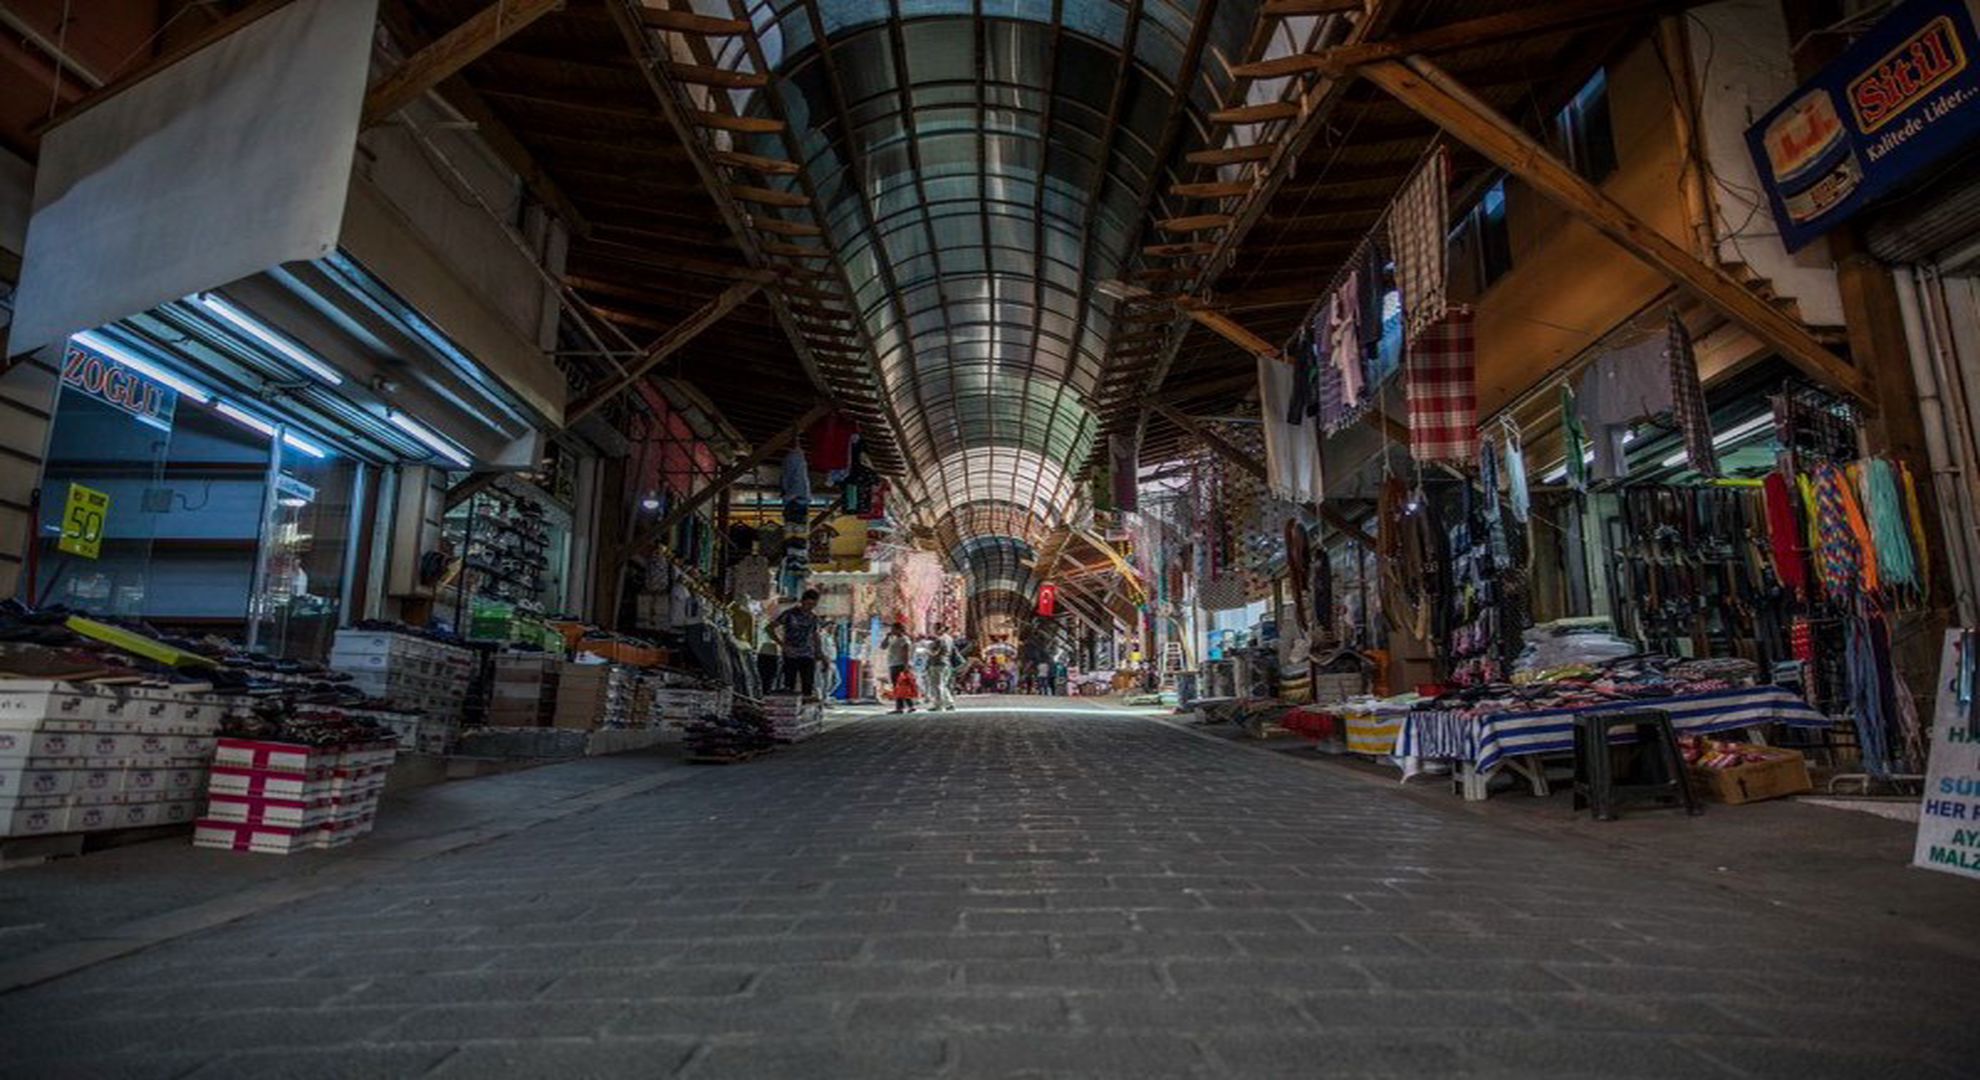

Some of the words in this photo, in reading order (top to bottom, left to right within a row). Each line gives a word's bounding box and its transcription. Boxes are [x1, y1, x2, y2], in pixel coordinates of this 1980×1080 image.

[1858, 32, 1953, 122] Sitil
[1866, 118, 1923, 161] Kalitede
[67, 506, 101, 542] 50
[1926, 799, 1966, 819] HER
